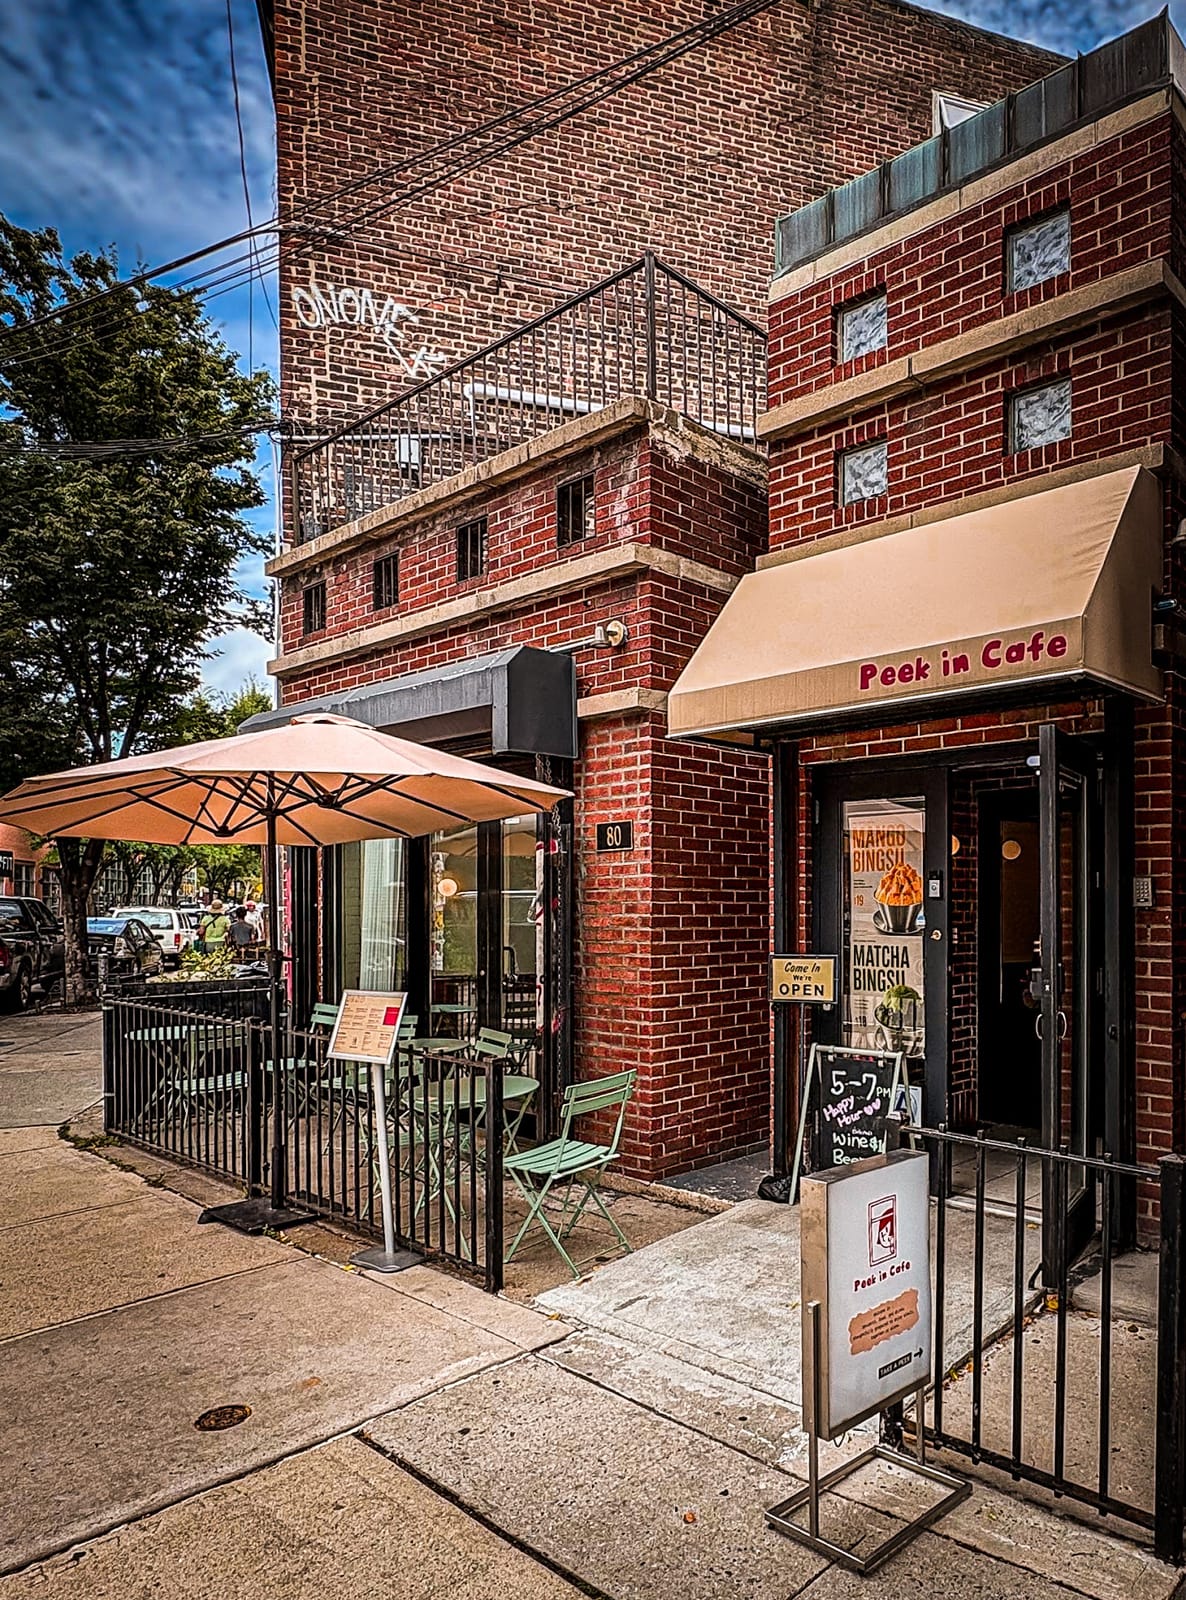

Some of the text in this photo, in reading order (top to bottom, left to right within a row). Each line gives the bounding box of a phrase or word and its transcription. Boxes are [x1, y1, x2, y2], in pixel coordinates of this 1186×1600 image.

[859, 631, 1068, 690] Peek in Cafe
[606, 825, 622, 847] 80
[852, 823, 906, 849] MANGO
[853, 848, 905, 873] BINGSU
[784, 961, 821, 973] Come In
[853, 944, 910, 969] MATCHA
[779, 983, 824, 996] OPEN
[853, 968, 905, 992] BINGSU
[822, 1095, 854, 1122] Happy
[837, 1110, 863, 1128] Hour
[832, 1131, 869, 1149] Wine
[832, 1148, 865, 1165] Bee
[854, 1261, 911, 1292] Peek in Cafe
